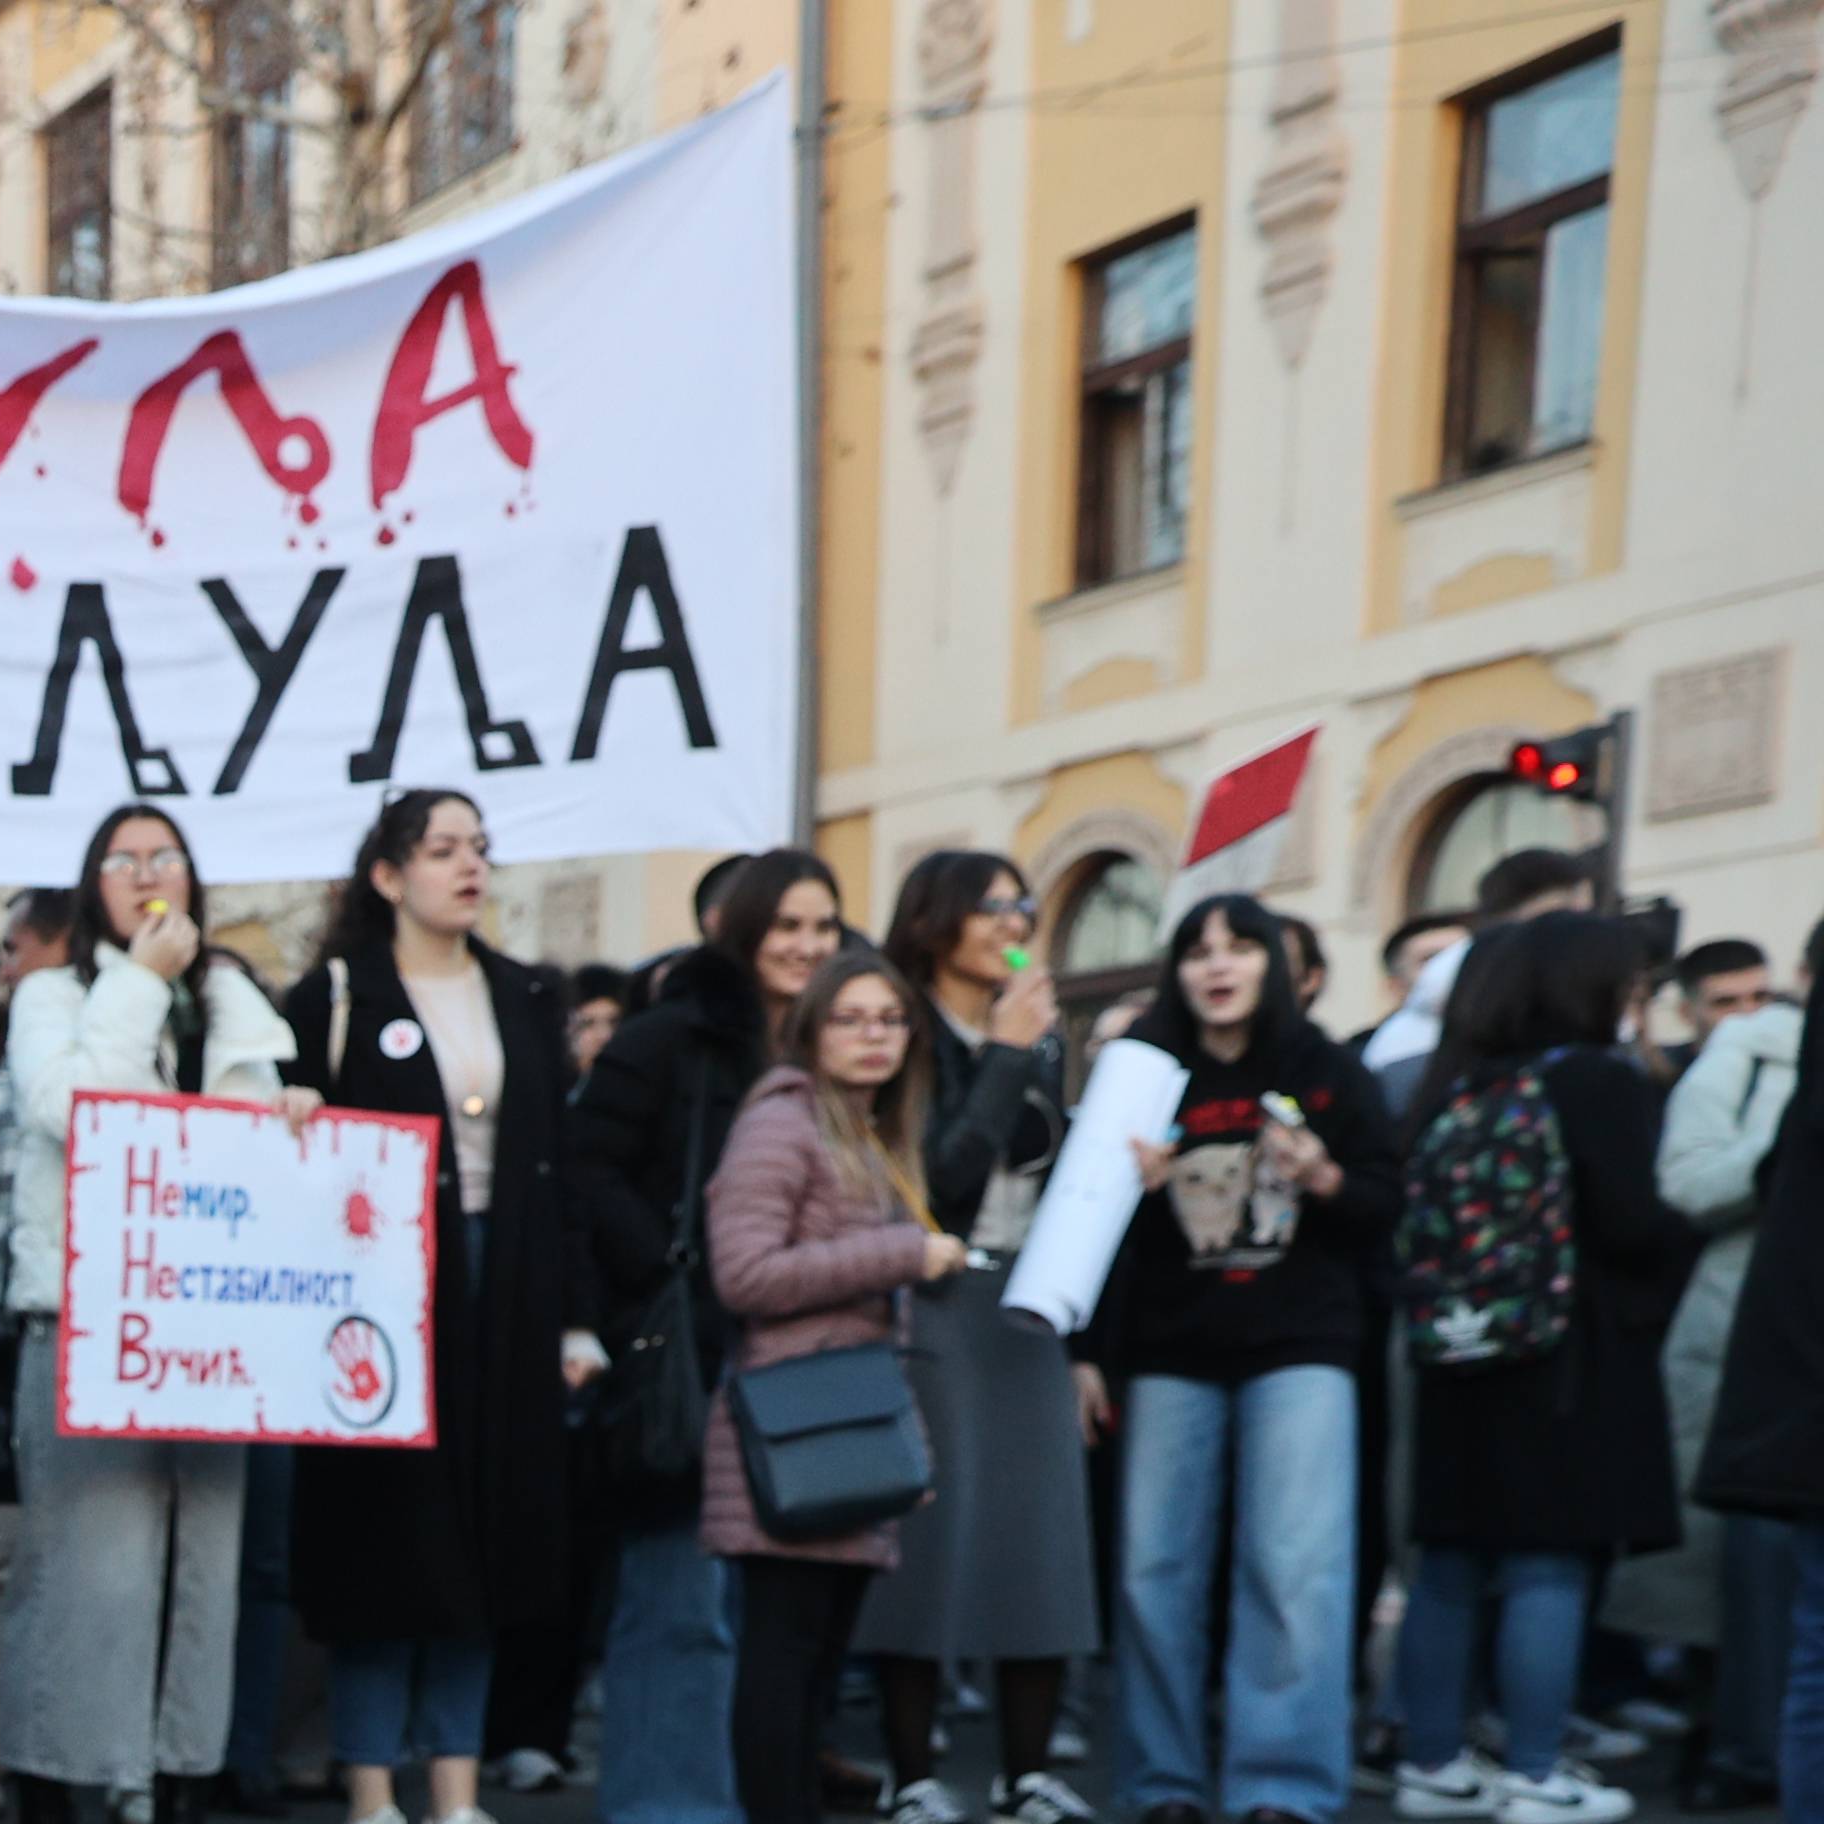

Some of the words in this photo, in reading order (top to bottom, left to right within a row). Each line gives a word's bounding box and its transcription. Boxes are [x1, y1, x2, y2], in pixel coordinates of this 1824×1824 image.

[11, 524, 718, 797] ЉУЉА
[124, 1146, 256, 1239] Немир.
[116, 1312, 255, 1390] Вучић.
